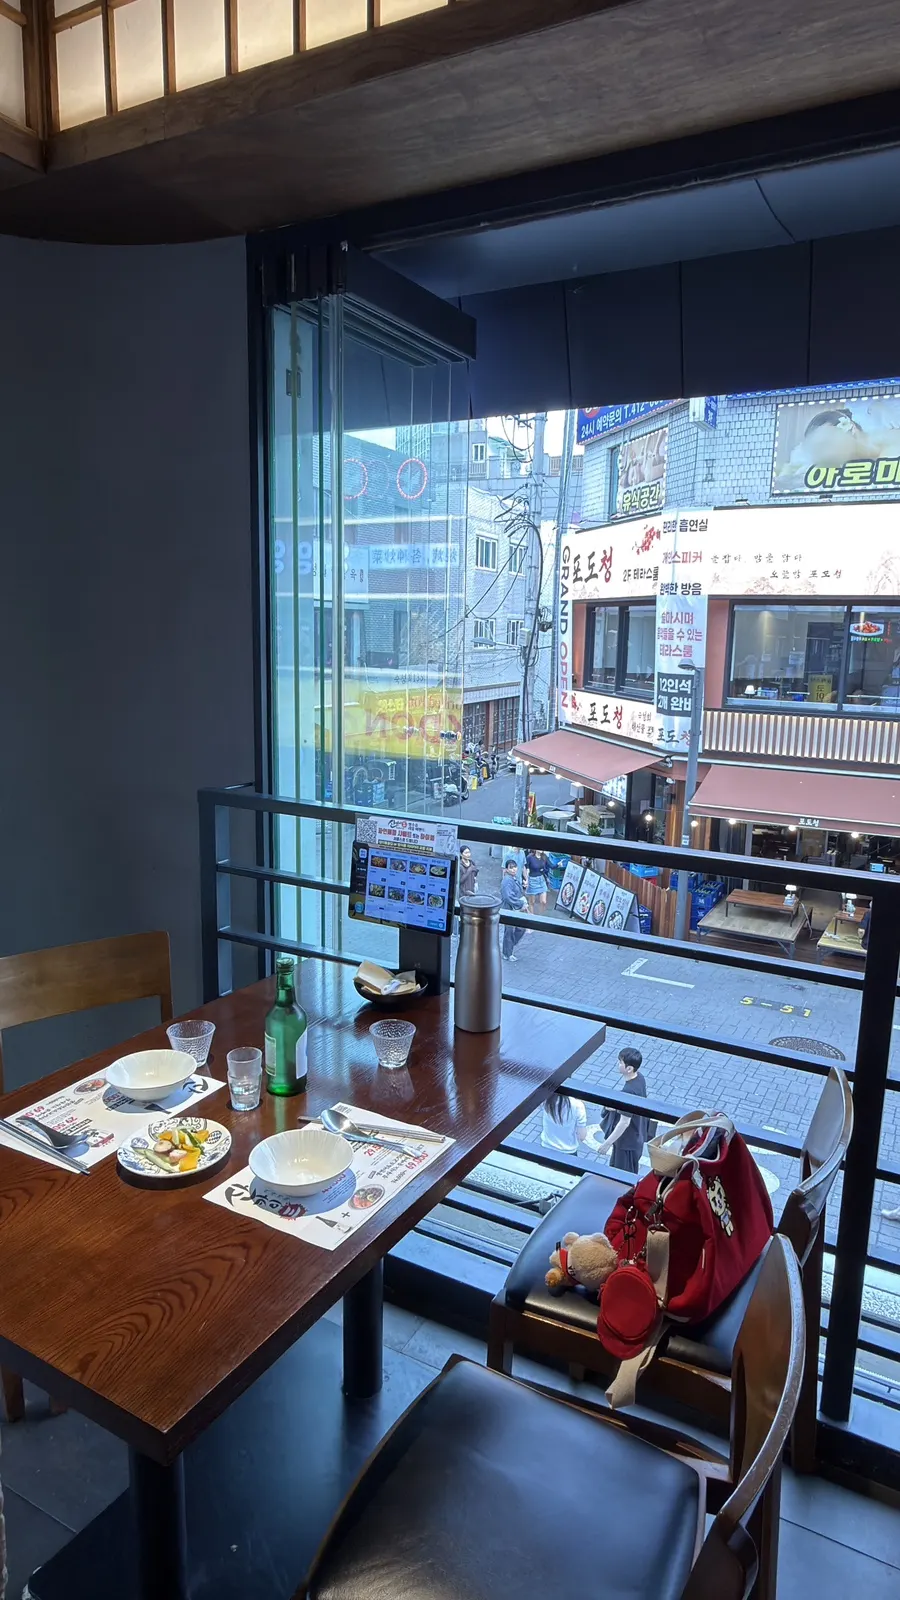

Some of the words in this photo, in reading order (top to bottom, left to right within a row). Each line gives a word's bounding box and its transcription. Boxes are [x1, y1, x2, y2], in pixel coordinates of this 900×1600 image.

[622, 482, 661, 512] 휴식공간
[679, 518, 709, 533] 흡연실
[572, 546, 613, 583] 포도청
[560, 545, 571, 635] GRAND
[680, 583, 702, 596] 방음
[677, 628, 685, 642] 수
[687, 628, 703, 641] 있는
[660, 645, 693, 657] 테라스룸
[559, 642, 569, 708] OPEN
[588, 702, 623, 729] 포도청
